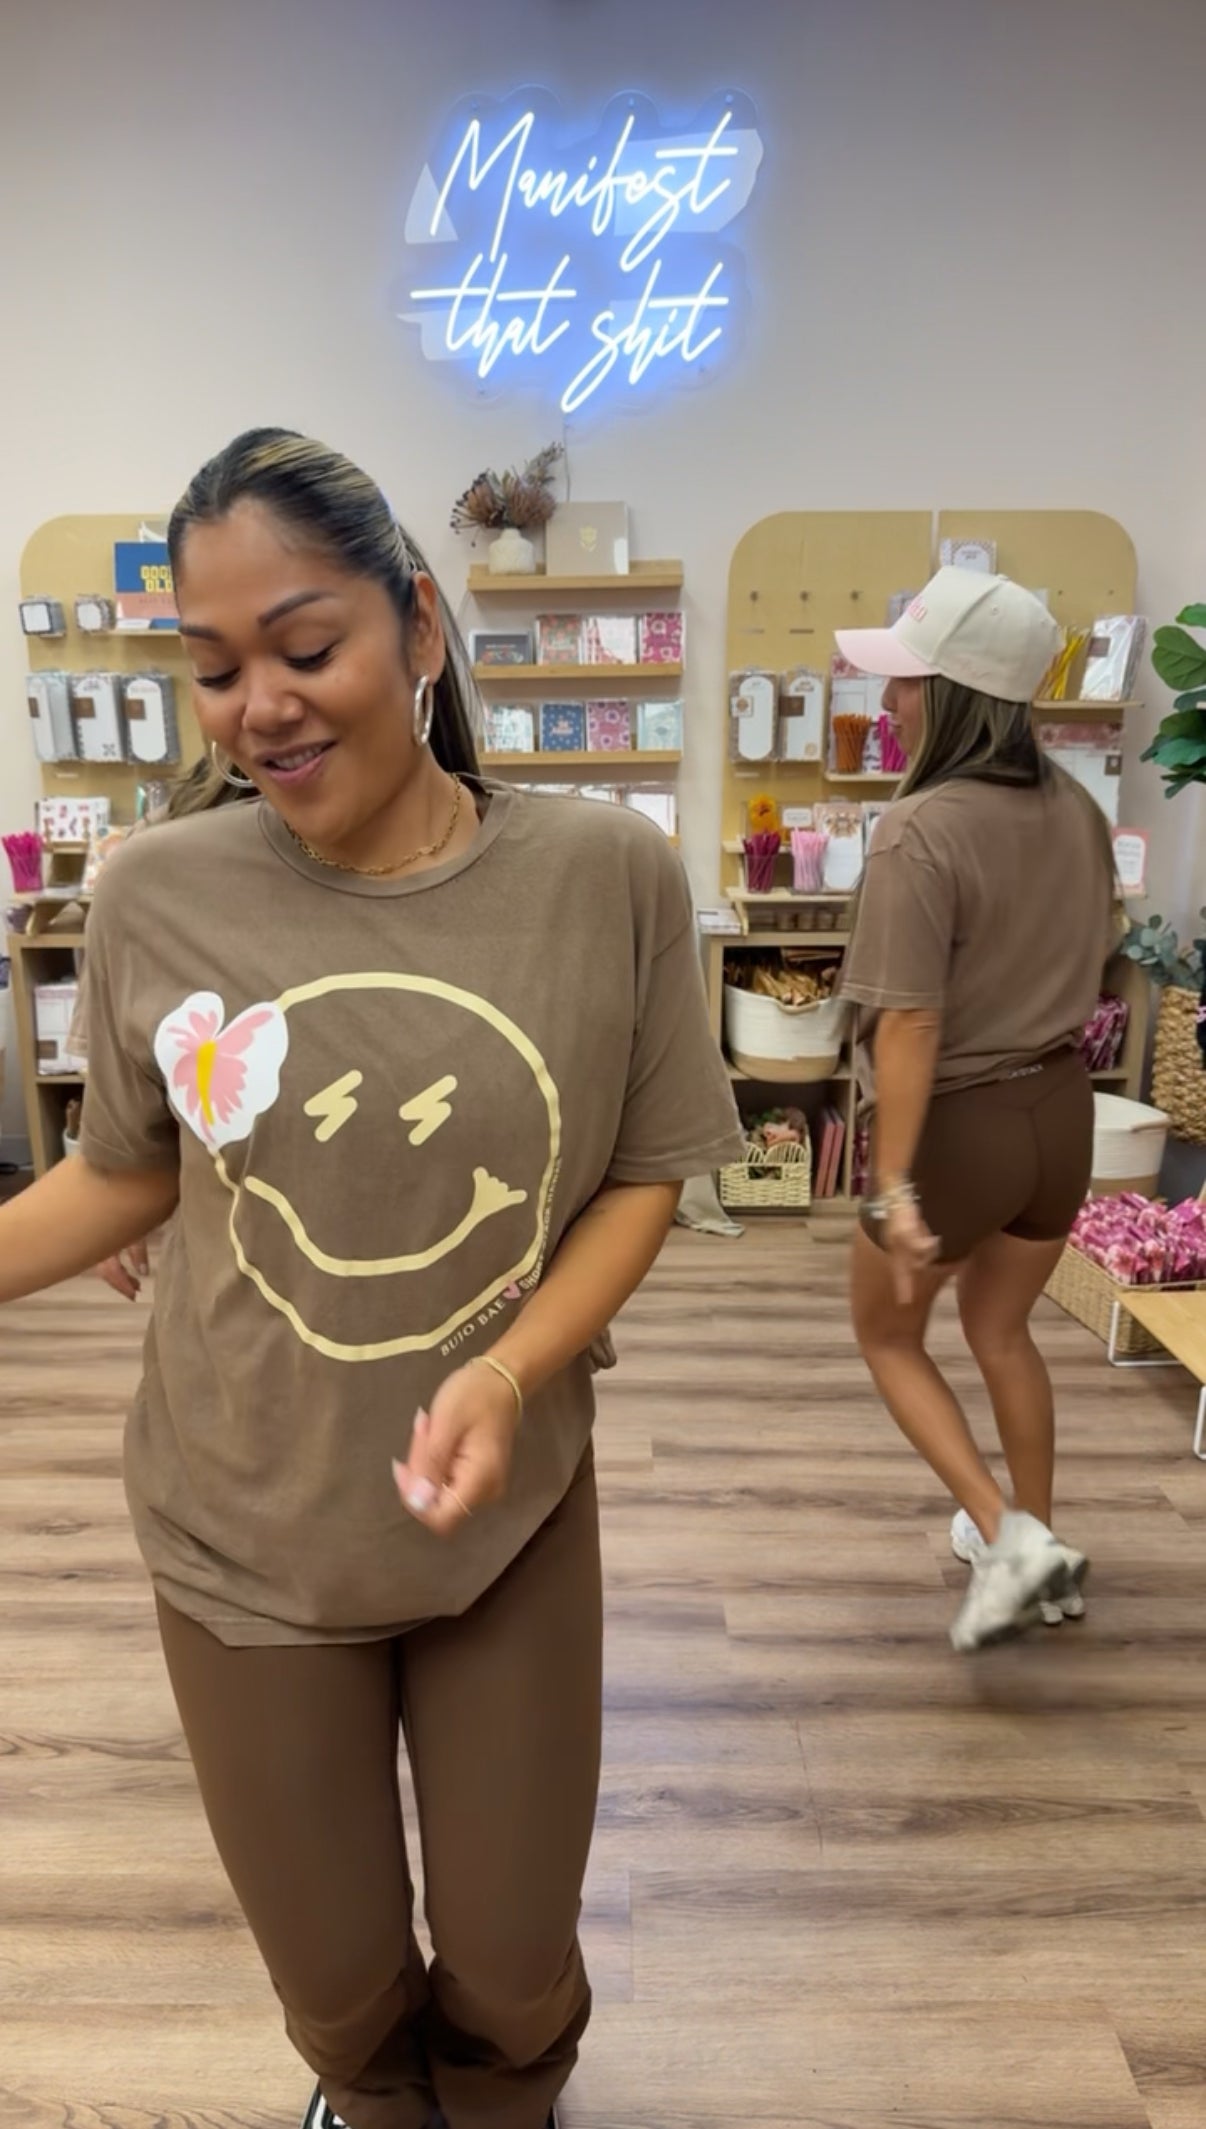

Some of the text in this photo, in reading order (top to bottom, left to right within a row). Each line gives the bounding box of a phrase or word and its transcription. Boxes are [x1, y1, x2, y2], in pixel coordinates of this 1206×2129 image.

[430, 111, 739, 273] Manifest
[410, 253, 729, 414] that shit
[439, 1323, 475, 1357] BUJO
[478, 1299, 506, 1326] BAE
